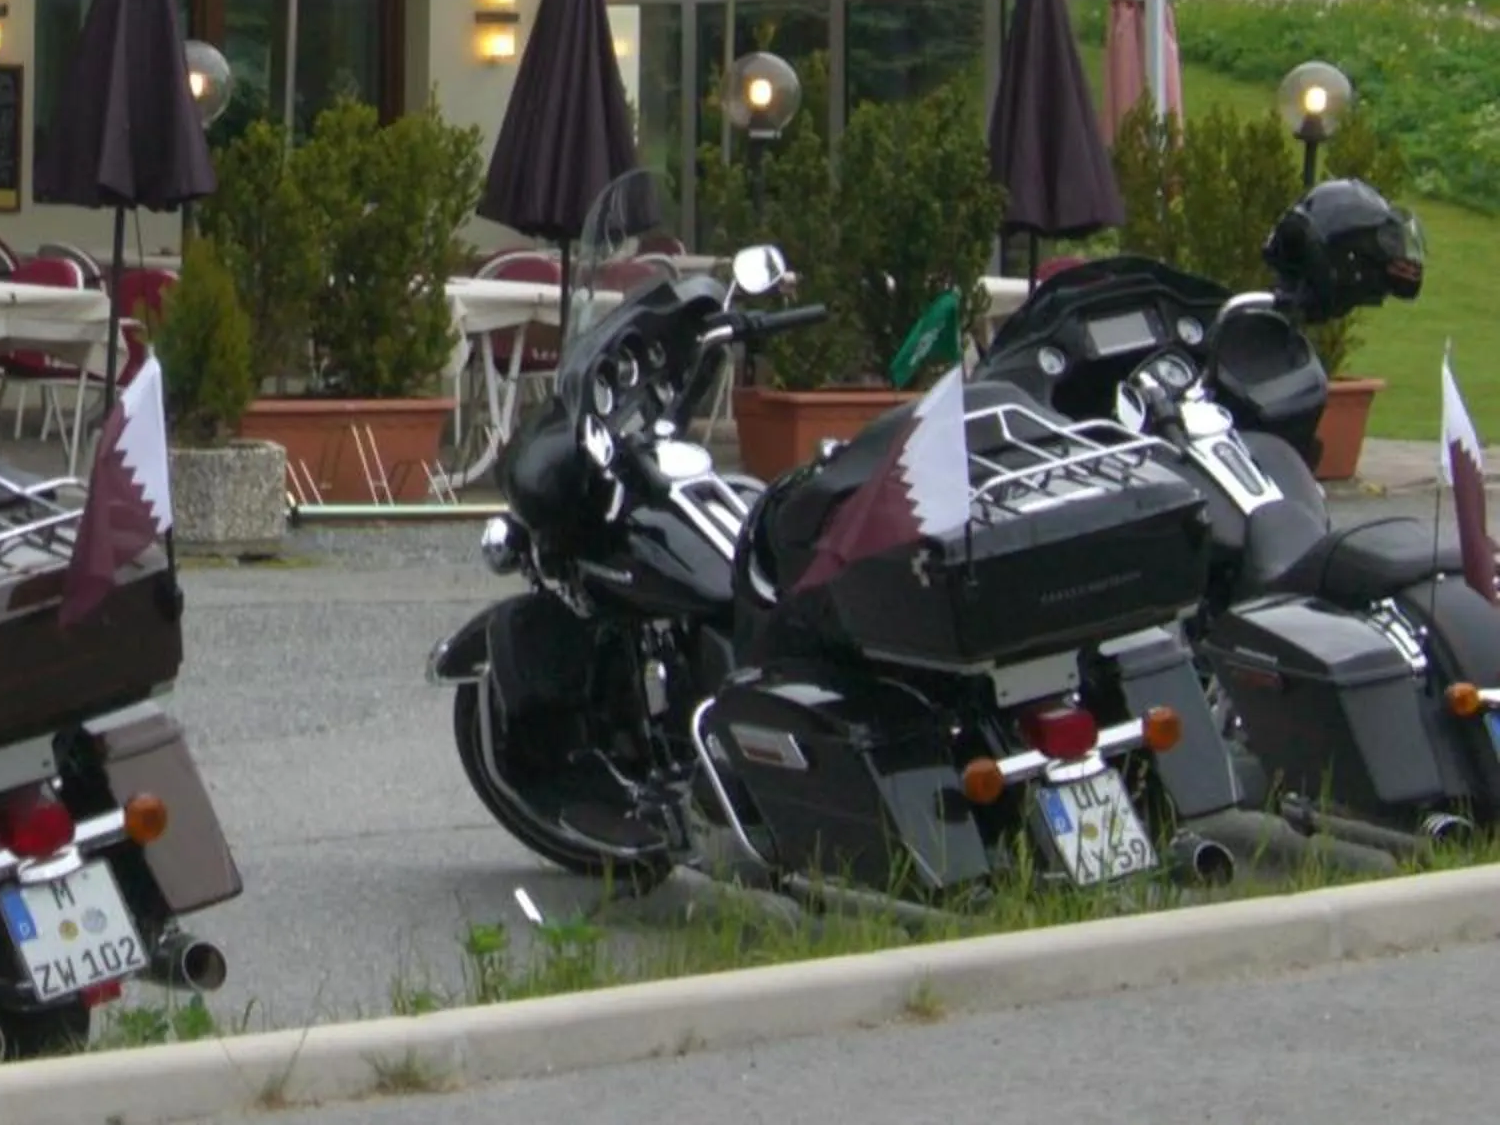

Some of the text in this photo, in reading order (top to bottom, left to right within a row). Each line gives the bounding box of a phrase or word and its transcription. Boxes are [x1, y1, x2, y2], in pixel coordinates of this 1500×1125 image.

[49, 876, 76, 911] M
[33, 935, 142, 997] ZW 102
